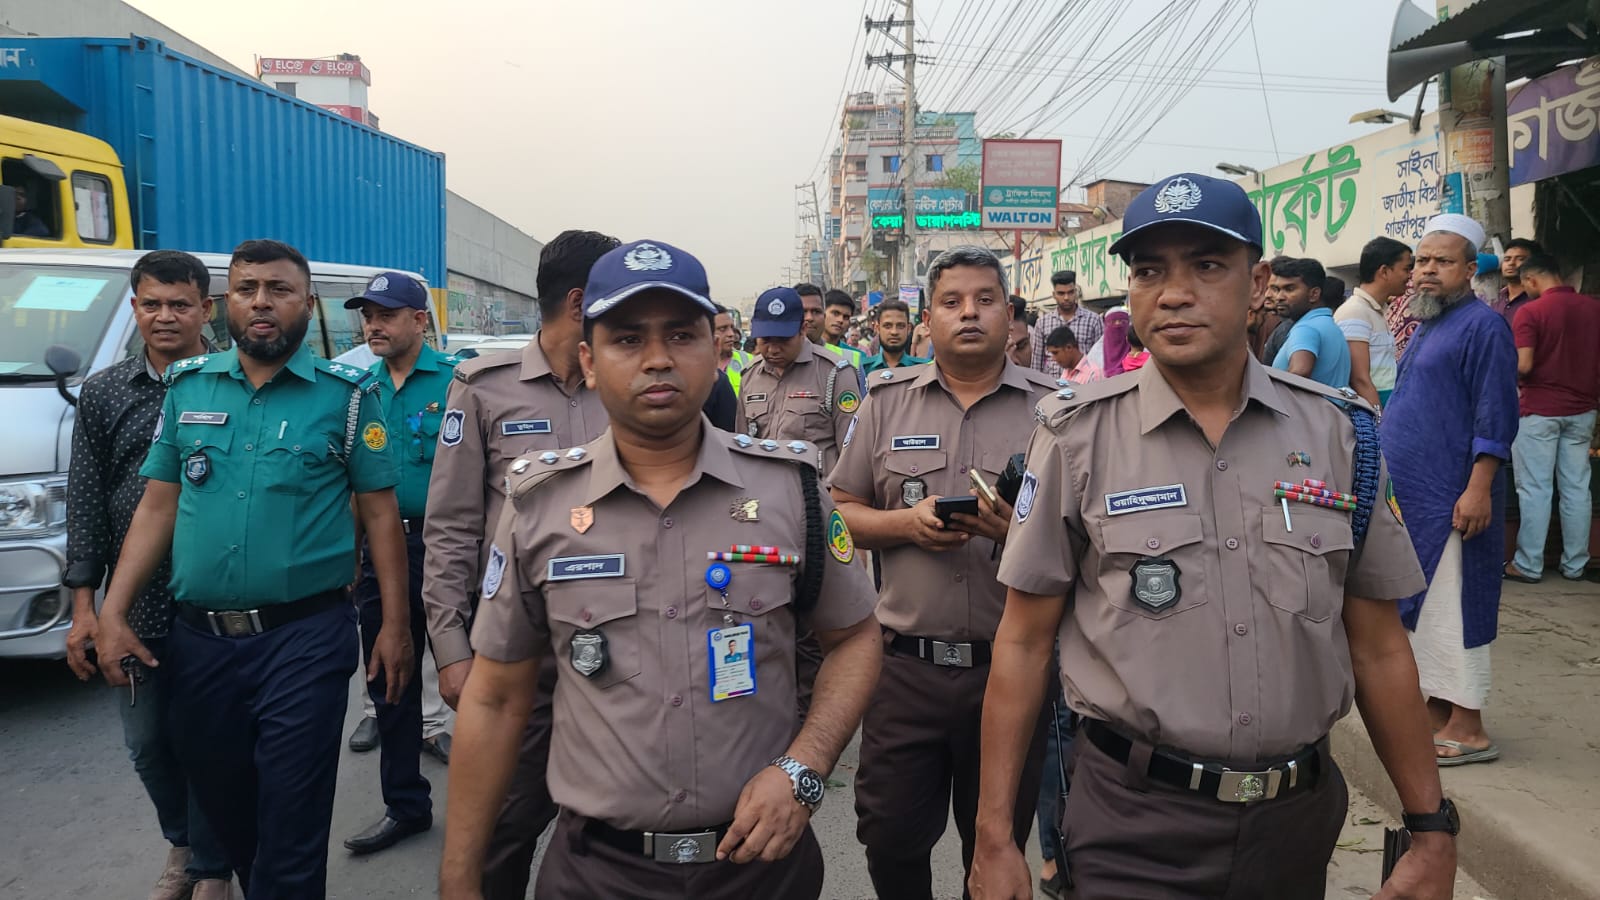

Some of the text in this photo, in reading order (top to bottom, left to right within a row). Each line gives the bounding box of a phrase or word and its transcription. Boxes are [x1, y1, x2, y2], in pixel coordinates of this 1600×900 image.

[275, 60, 302, 70] ELCO
[327, 61, 354, 72] ELCO
[1382, 181, 1416, 213] জাতীয়
[1418, 179, 1438, 205] বিশ্ব
[988, 211, 1052, 224] WALTON
